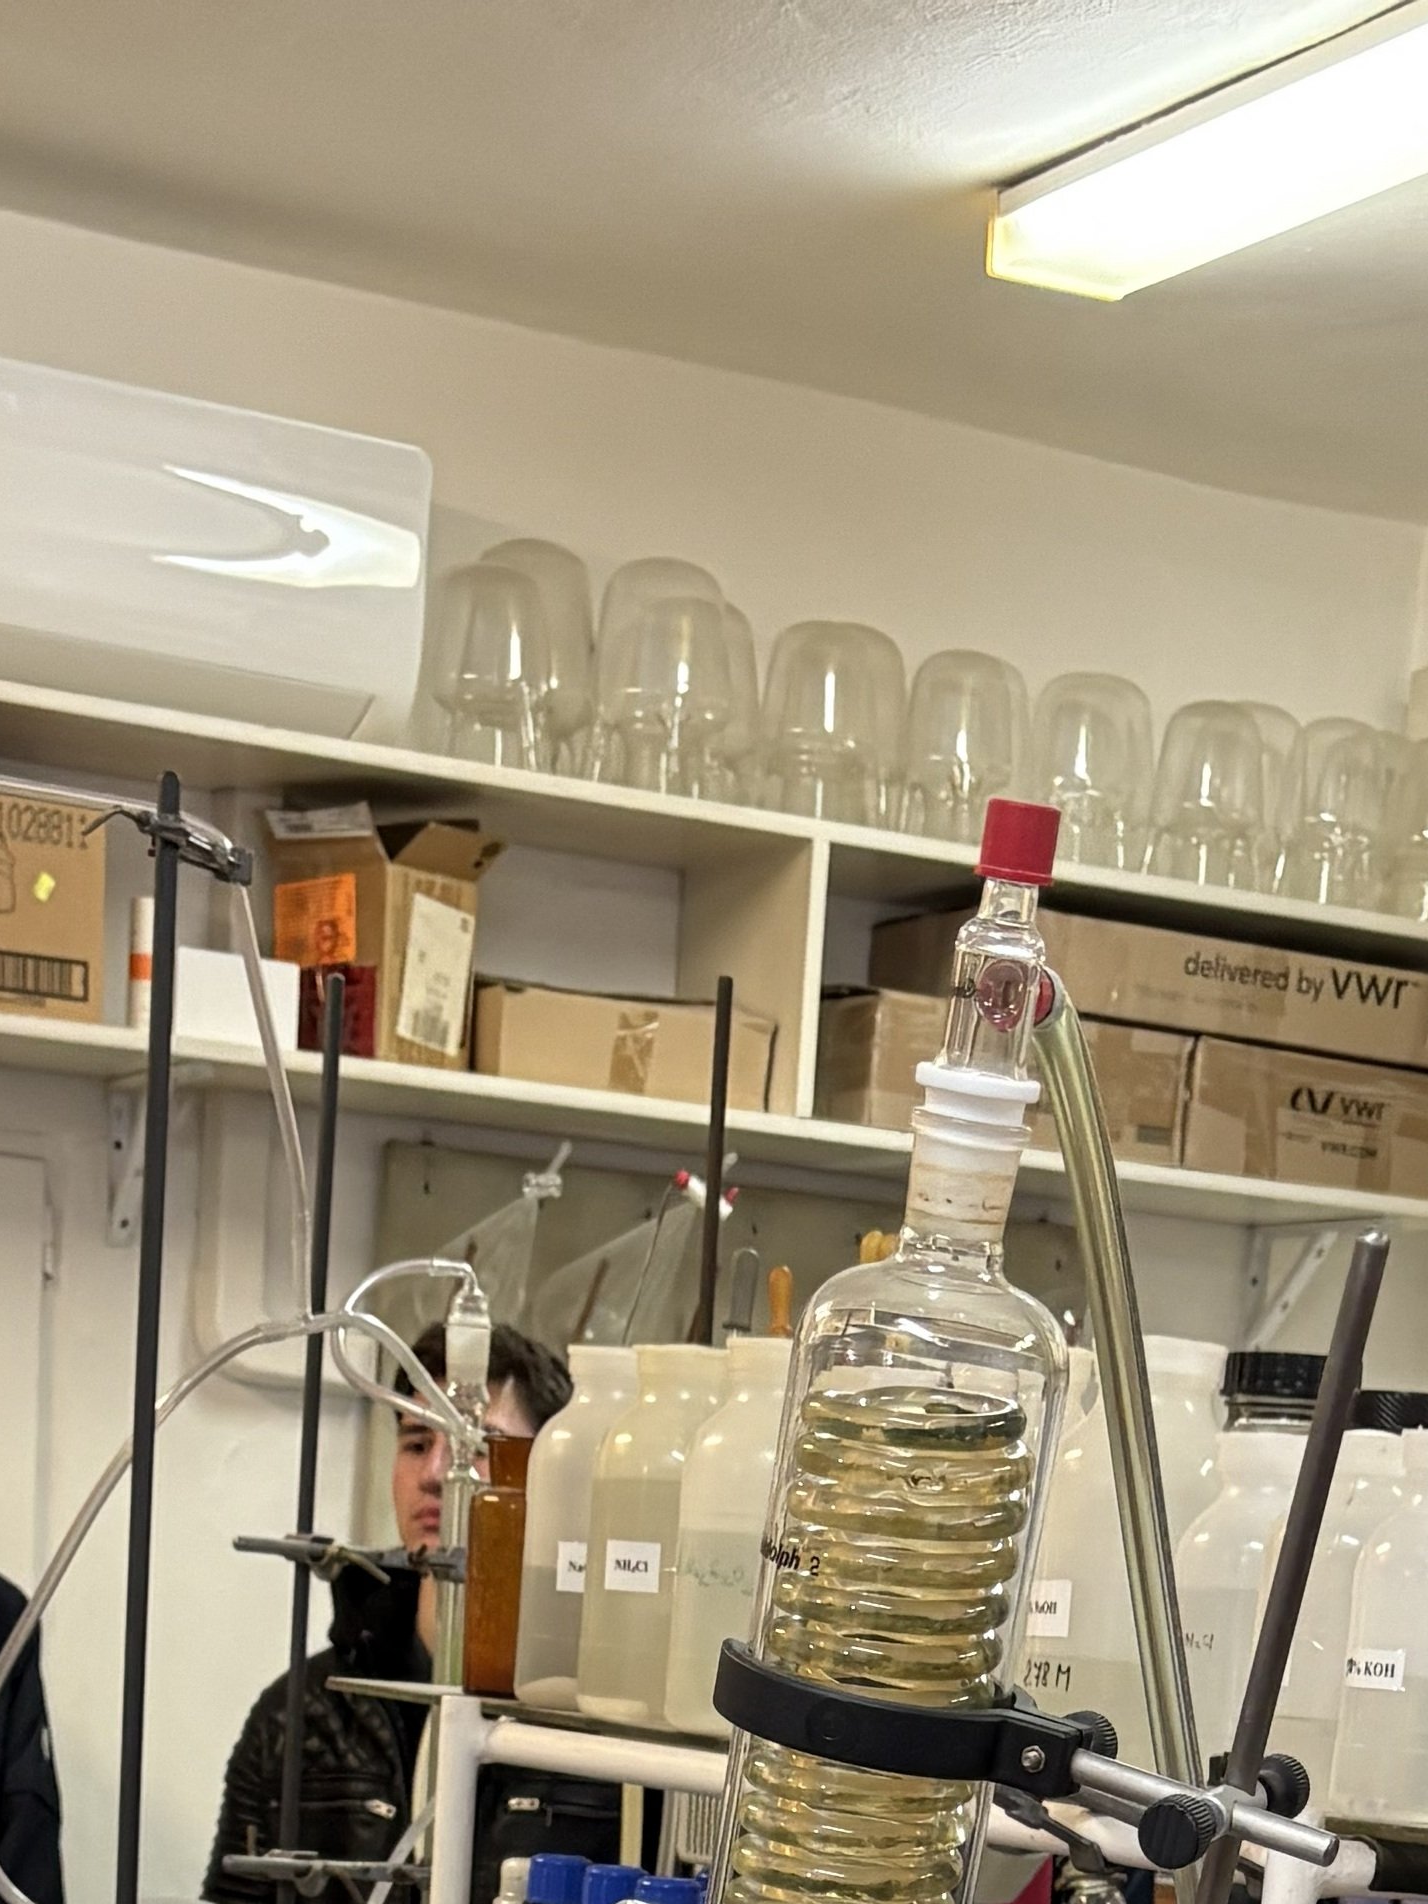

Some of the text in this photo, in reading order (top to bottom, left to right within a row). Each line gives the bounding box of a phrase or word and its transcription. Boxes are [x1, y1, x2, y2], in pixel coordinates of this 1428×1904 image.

[1184, 952, 1290, 992] delivered
[1297, 969, 1325, 1002] by
[1363, 1661, 1396, 1679] KOH
